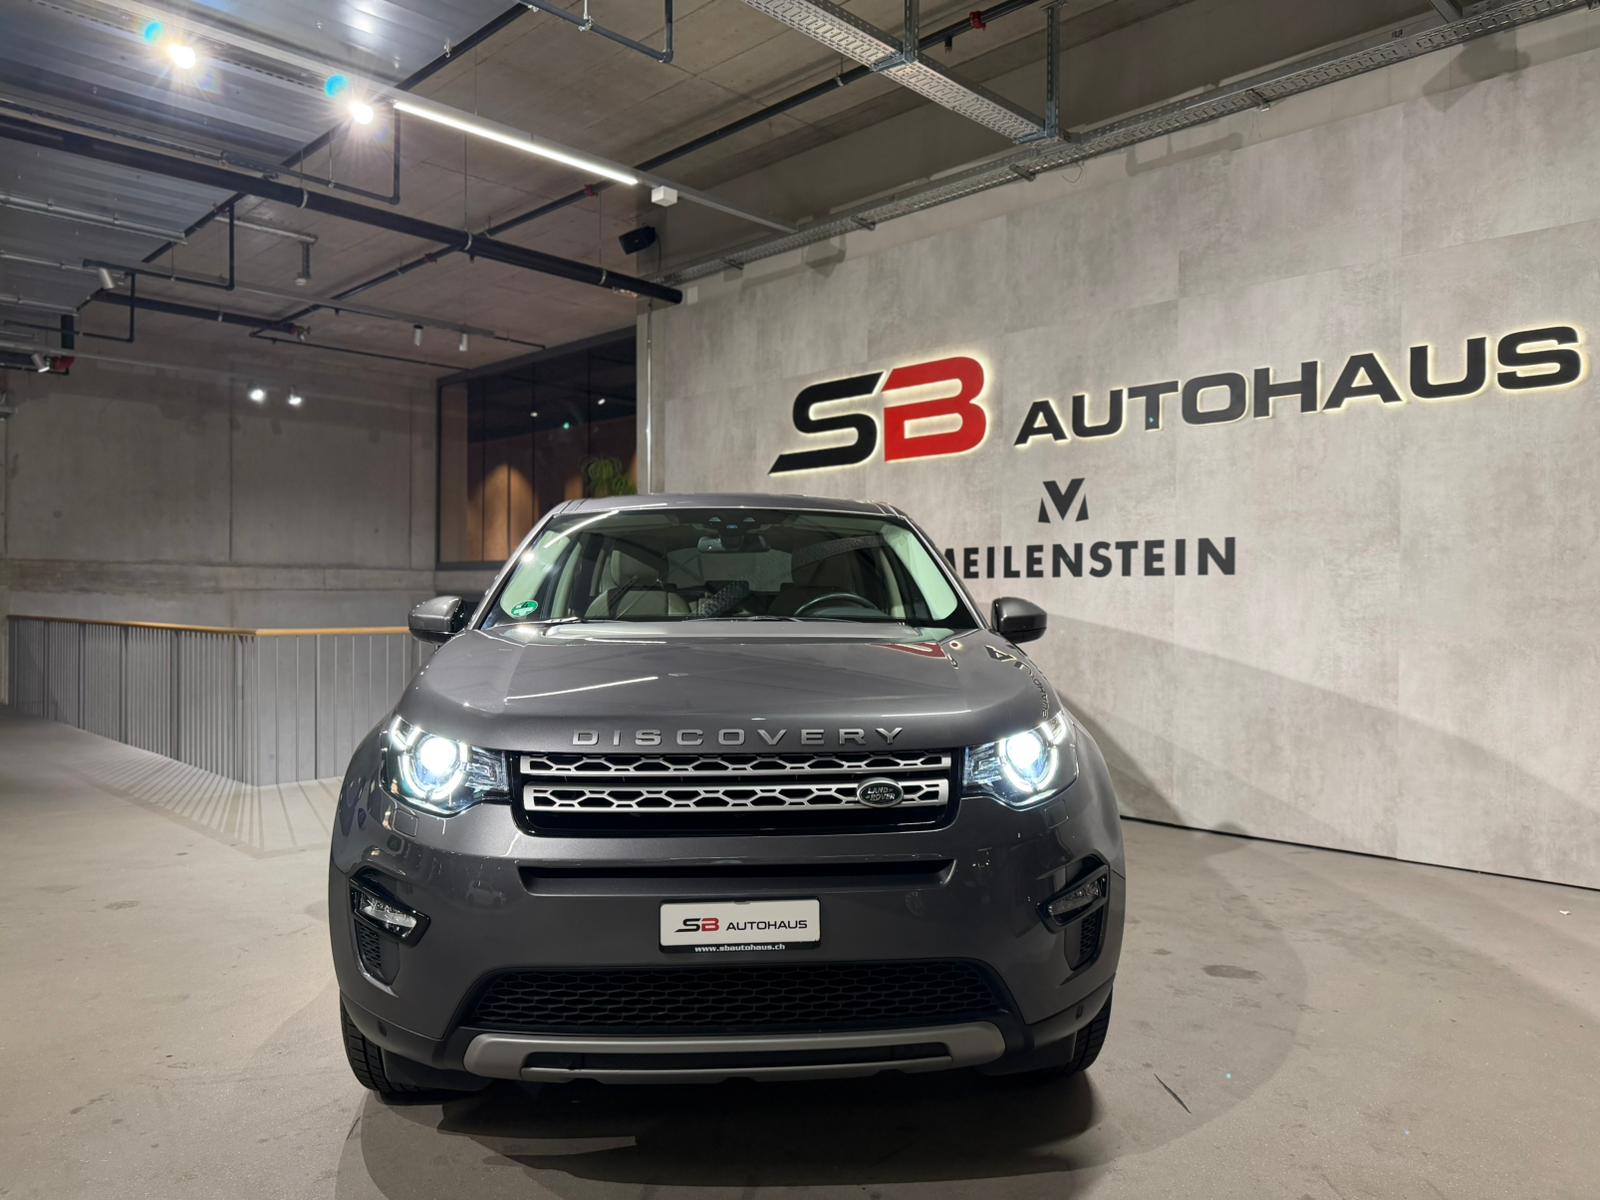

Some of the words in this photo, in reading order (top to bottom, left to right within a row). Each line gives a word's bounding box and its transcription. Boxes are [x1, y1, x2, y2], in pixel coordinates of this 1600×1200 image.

[768, 356, 987, 475] SB
[1013, 326, 1582, 446] AUTOHAUS
[572, 727, 903, 746] DISCOVERY
[674, 918, 719, 933] SB
[726, 920, 807, 931] AUTOHAUS
[695, 944, 785, 952] www.sbautohaus.ch
